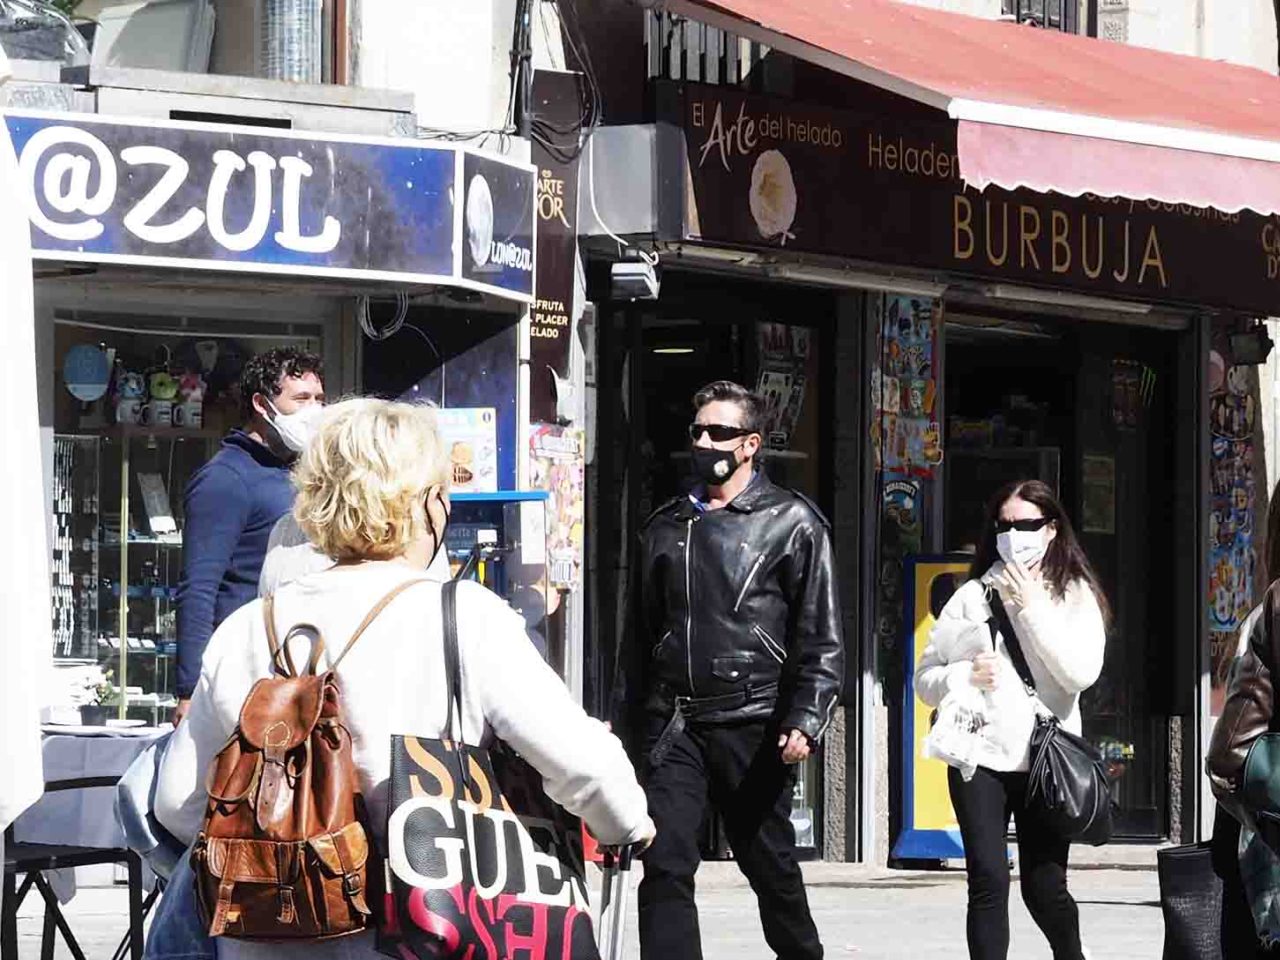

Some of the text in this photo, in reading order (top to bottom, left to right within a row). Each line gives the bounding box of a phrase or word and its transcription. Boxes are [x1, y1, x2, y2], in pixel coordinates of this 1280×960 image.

[692, 101, 842, 173] El Arte del helado
[868, 134, 958, 178] Helader
[537, 178, 565, 196] ARTE
[537, 193, 571, 228] 'OR
[953, 194, 1168, 288] BURBUJA
[531, 299, 565, 312] SFRUTA
[530, 327, 559, 338] ELADO
[535, 314, 569, 326] PLACER
